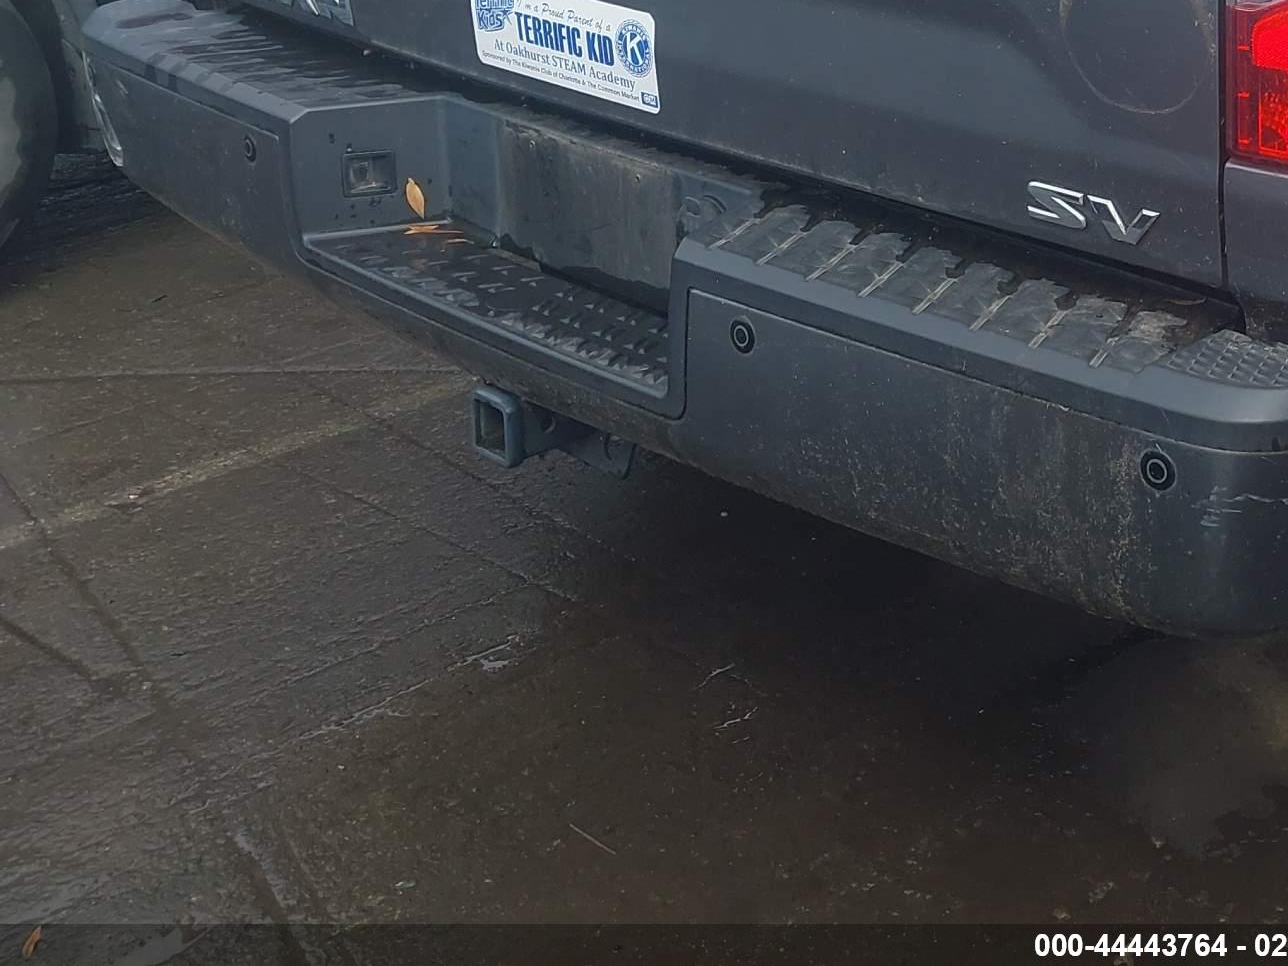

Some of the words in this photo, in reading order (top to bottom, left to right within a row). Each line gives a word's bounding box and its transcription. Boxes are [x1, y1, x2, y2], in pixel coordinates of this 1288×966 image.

[477, 10, 504, 29] Kids
[515, 11, 582, 57] TERRIFIC
[586, 31, 614, 66] KID
[541, 3, 565, 19] Proud
[567, 10, 594, 26] Parent
[595, 18, 603, 32] of
[494, 39, 504, 51] At
[506, 42, 551, 65] Oakhurst
[552, 55, 586, 76] STEAM
[589, 66, 635, 92] Academy
[1027, 181, 1160, 245] SV
